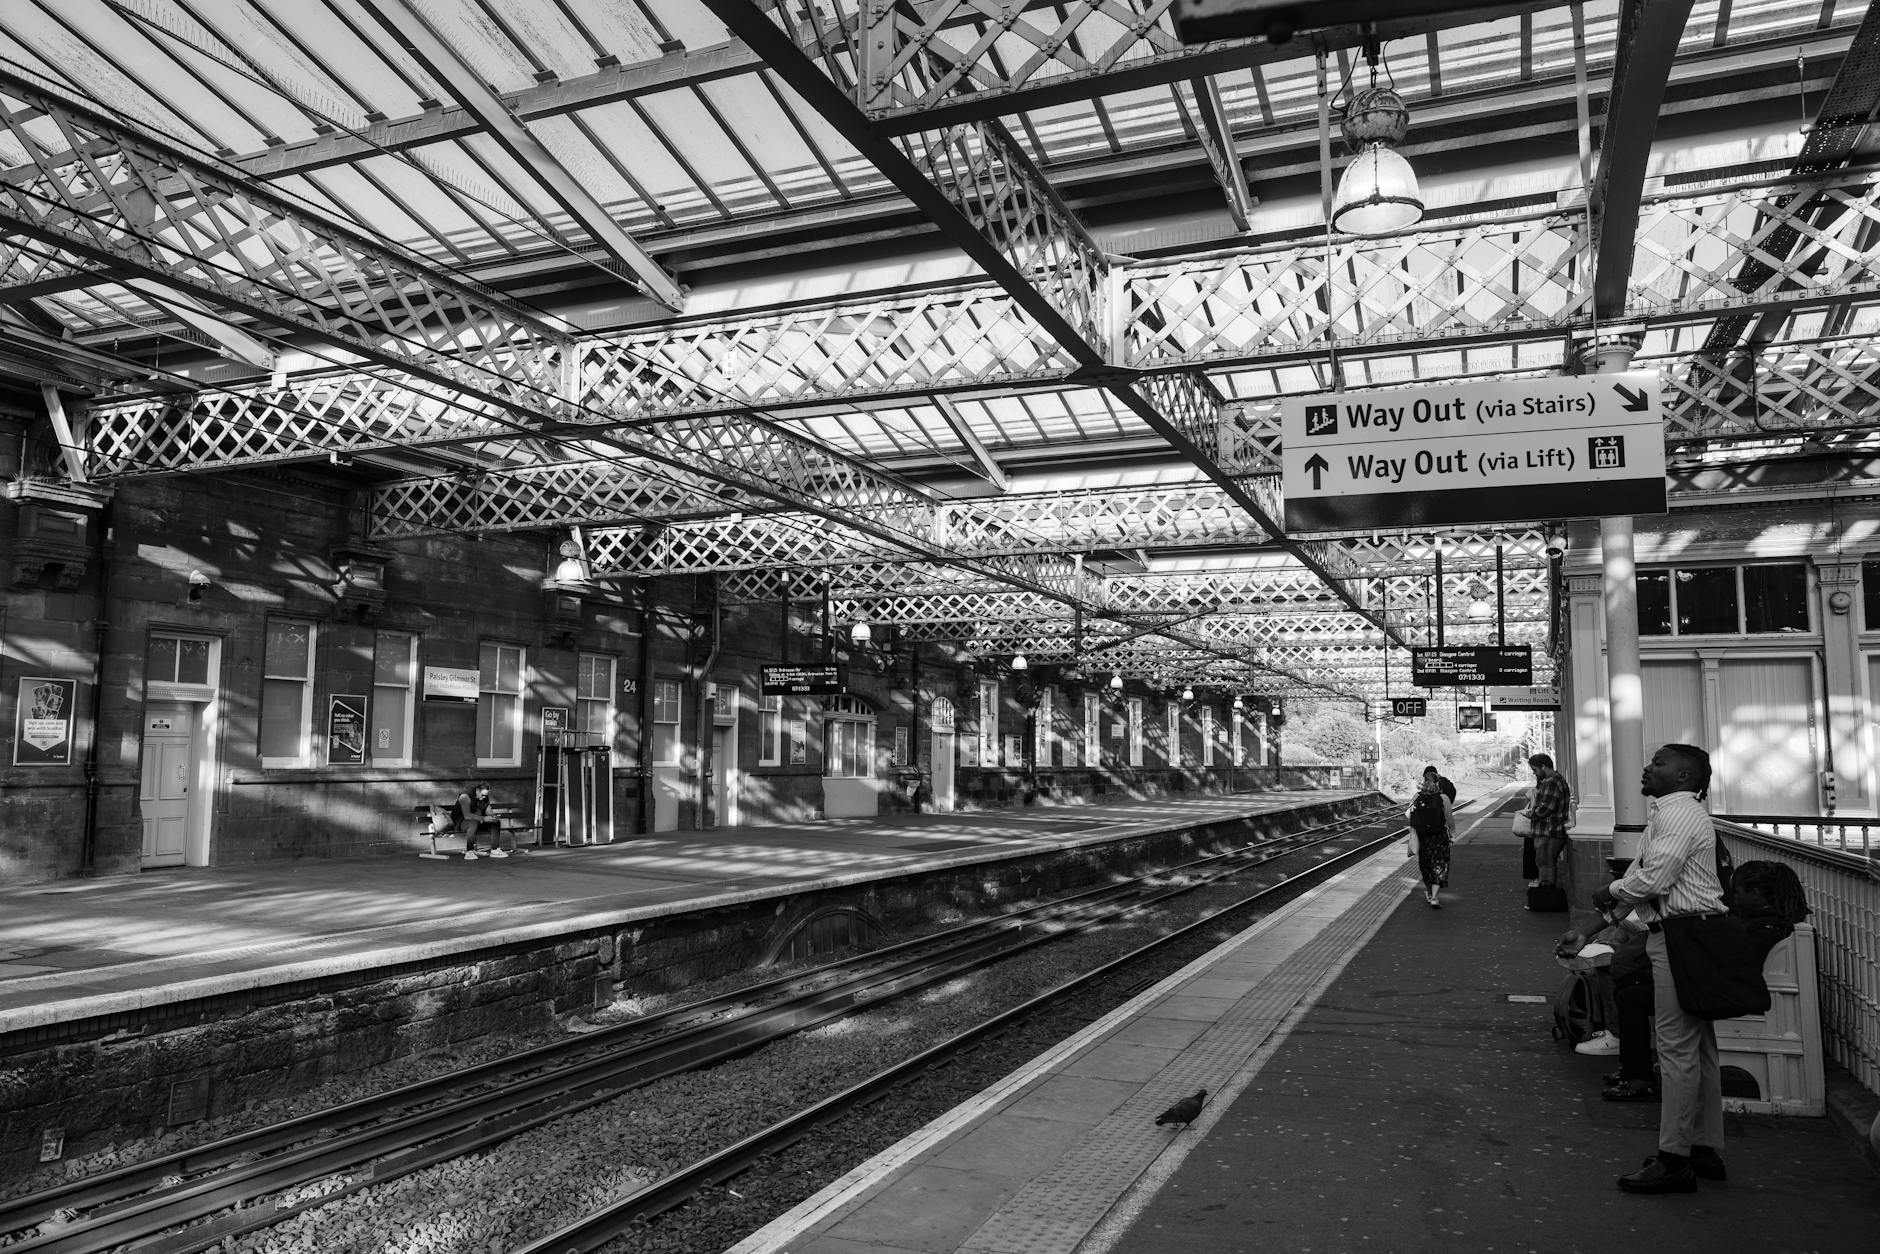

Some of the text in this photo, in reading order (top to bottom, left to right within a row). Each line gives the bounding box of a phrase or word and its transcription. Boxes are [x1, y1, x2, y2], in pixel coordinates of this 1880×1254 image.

[1347, 392, 1597, 432] Way Out (via Stairs)
[1348, 447, 1576, 484] Way Out (via Lift)
[430, 672, 449, 682] Paisley
[450, 674, 469, 683] Gilmour
[623, 679, 637, 693] 24
[1396, 701, 1422, 714] OFF
[553, 711, 560, 720] by
